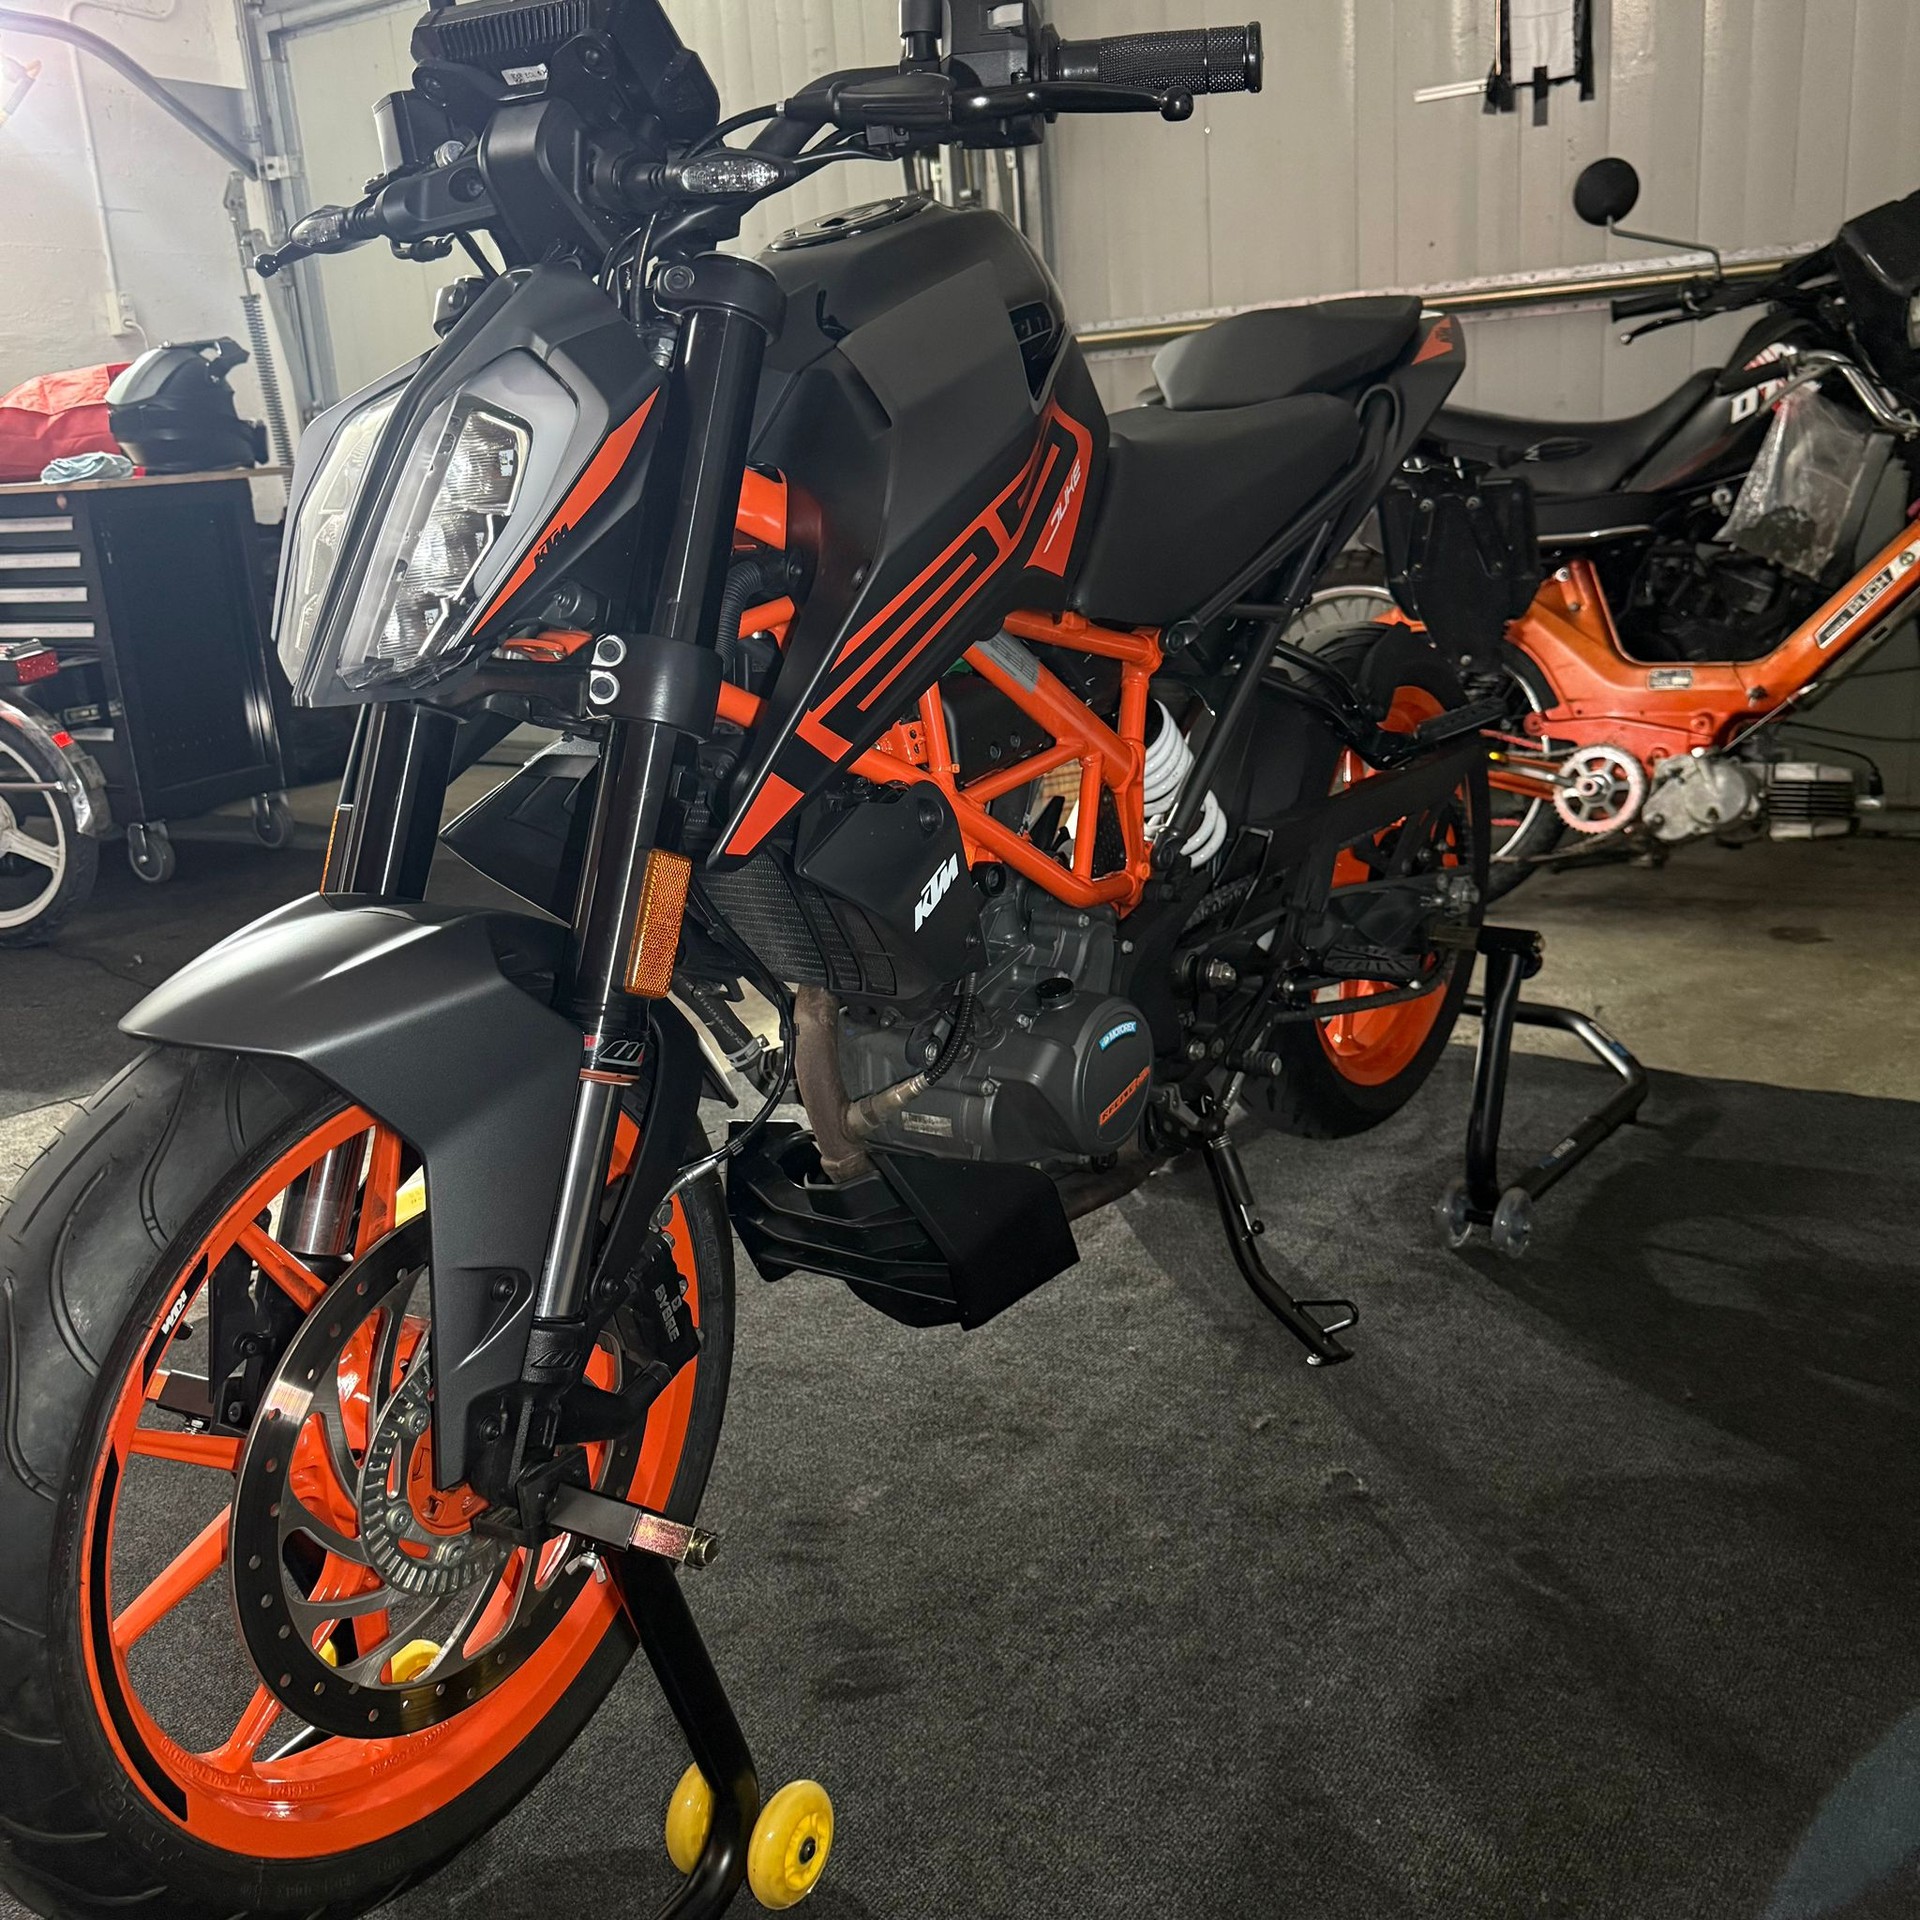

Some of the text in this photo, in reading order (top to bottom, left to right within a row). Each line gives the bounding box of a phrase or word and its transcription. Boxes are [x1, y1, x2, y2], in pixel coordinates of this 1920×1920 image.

[914, 852, 959, 932] KTM
[161, 1289, 188, 1335] KTM
[654, 1283, 681, 1343] BYBRE
